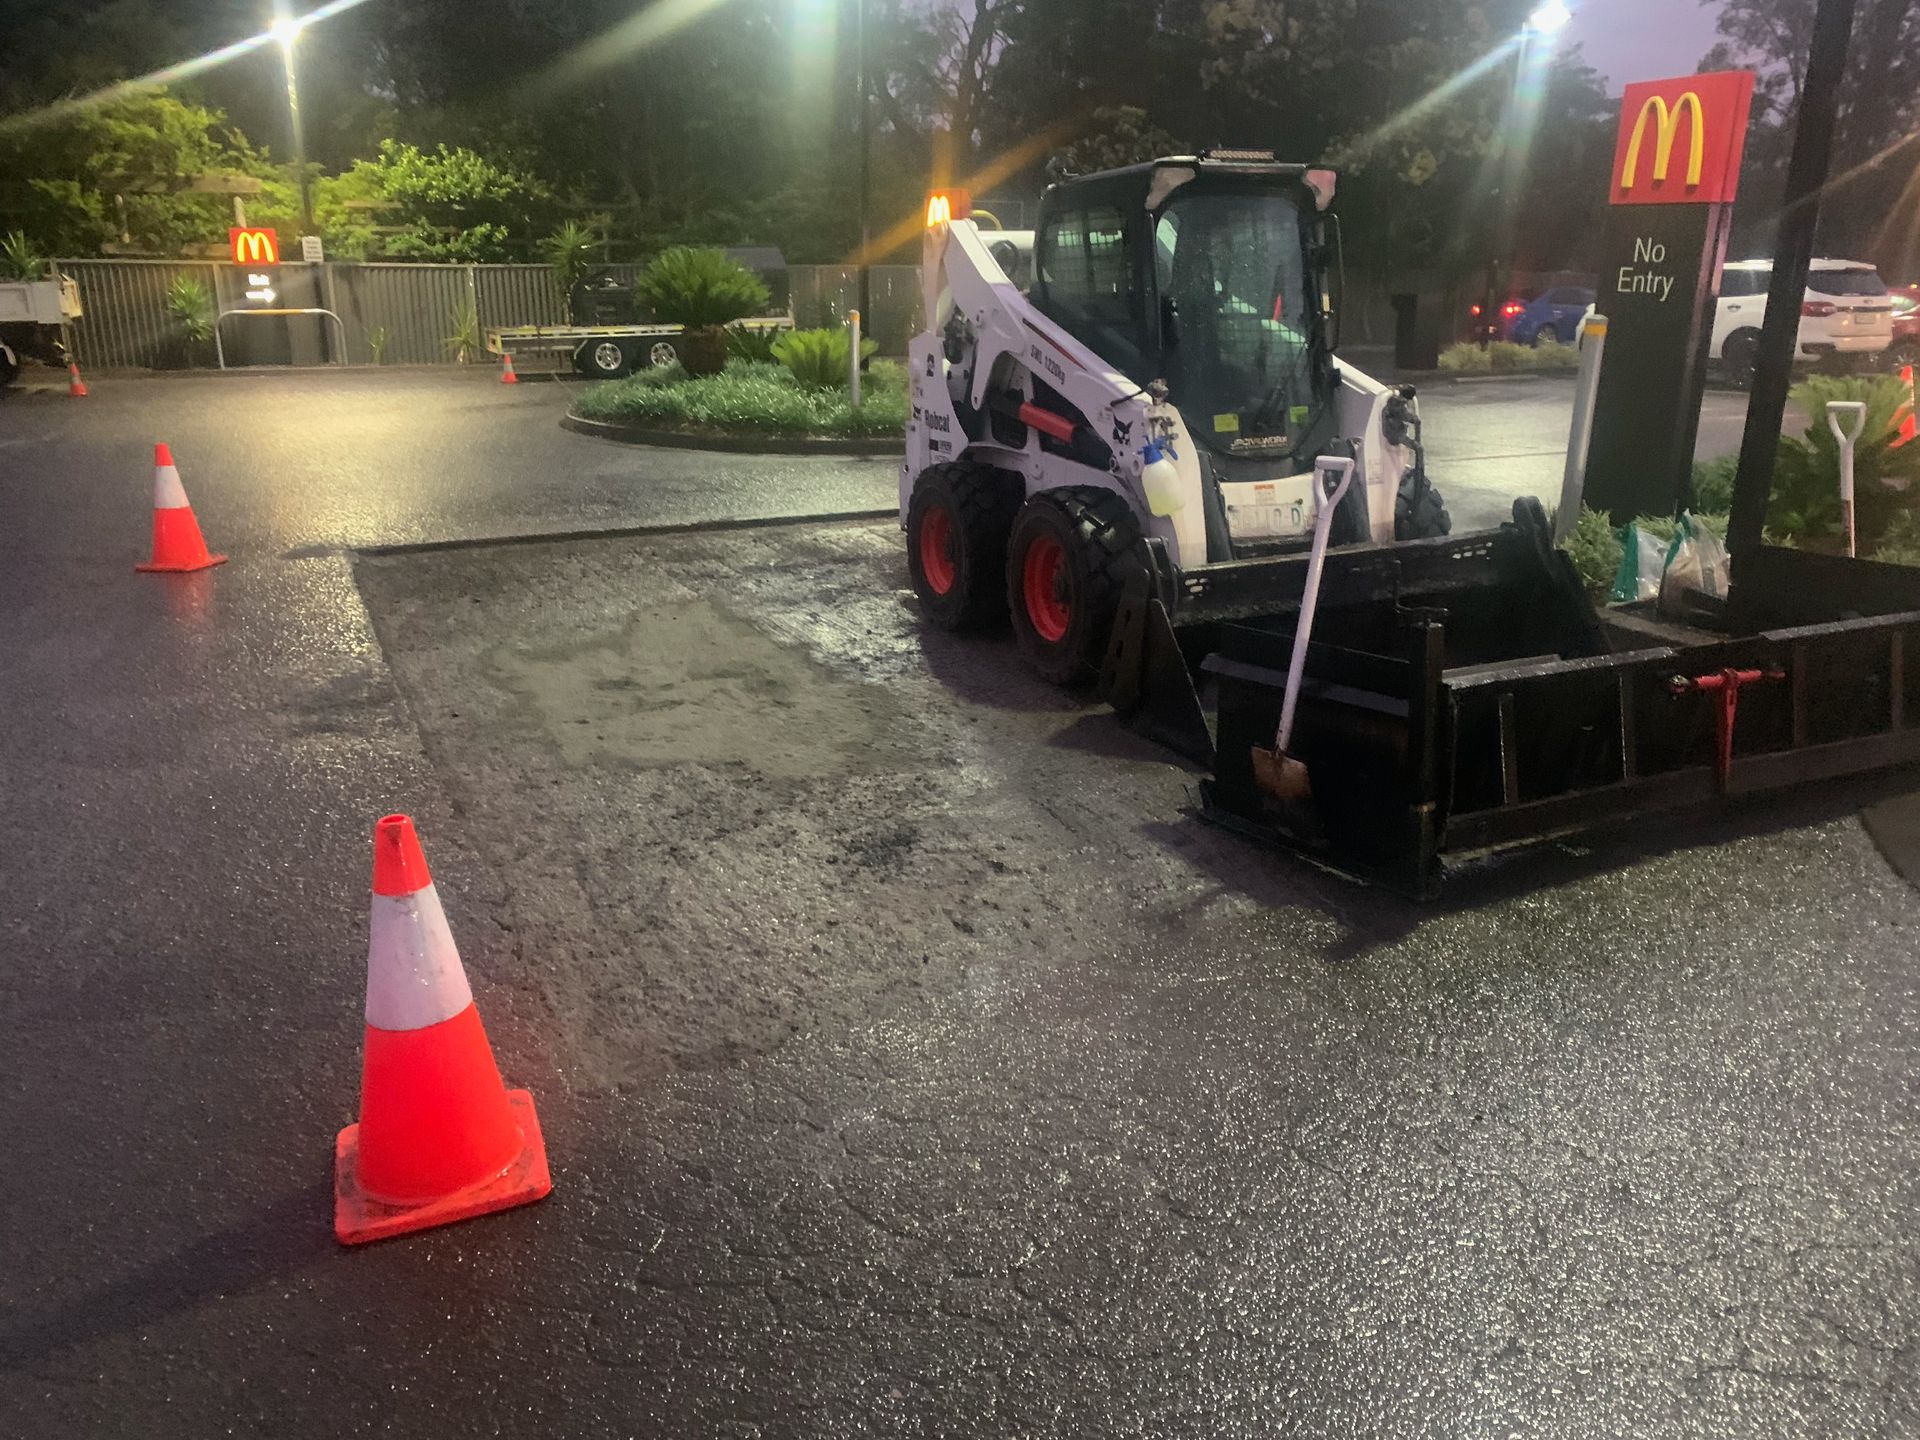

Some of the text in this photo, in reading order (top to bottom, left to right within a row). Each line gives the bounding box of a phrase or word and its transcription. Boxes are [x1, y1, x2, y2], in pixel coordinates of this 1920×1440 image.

[1621, 92, 1704, 188] M
[237, 231, 275, 263] M
[1634, 237, 1665, 262] No
[1617, 266, 1674, 301] Entry
[924, 409, 951, 433] Bobcat
